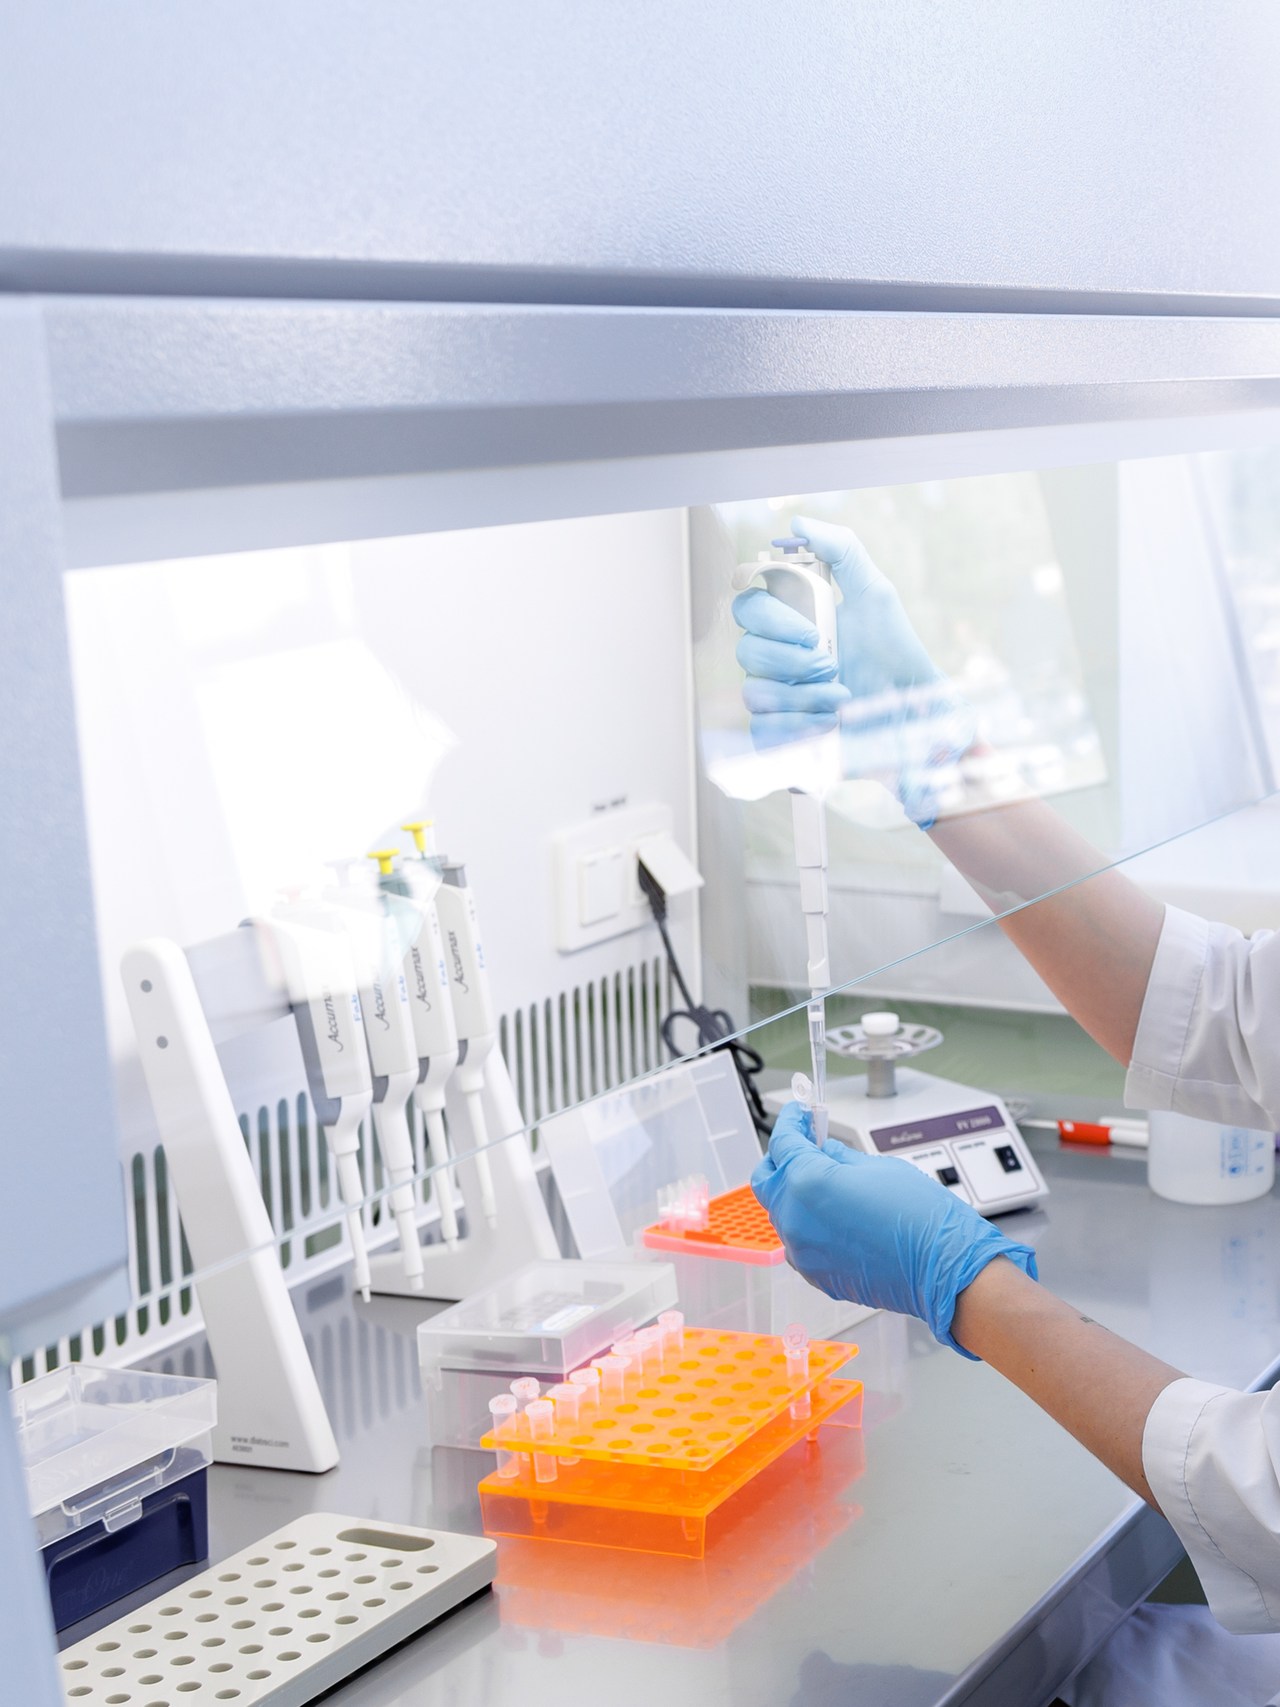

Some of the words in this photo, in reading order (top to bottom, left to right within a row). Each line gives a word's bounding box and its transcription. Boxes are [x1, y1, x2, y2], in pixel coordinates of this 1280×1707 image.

[411, 946, 431, 1012] Accumax
[448, 930, 469, 994] Accumax
[373, 975, 390, 1030] Accum
